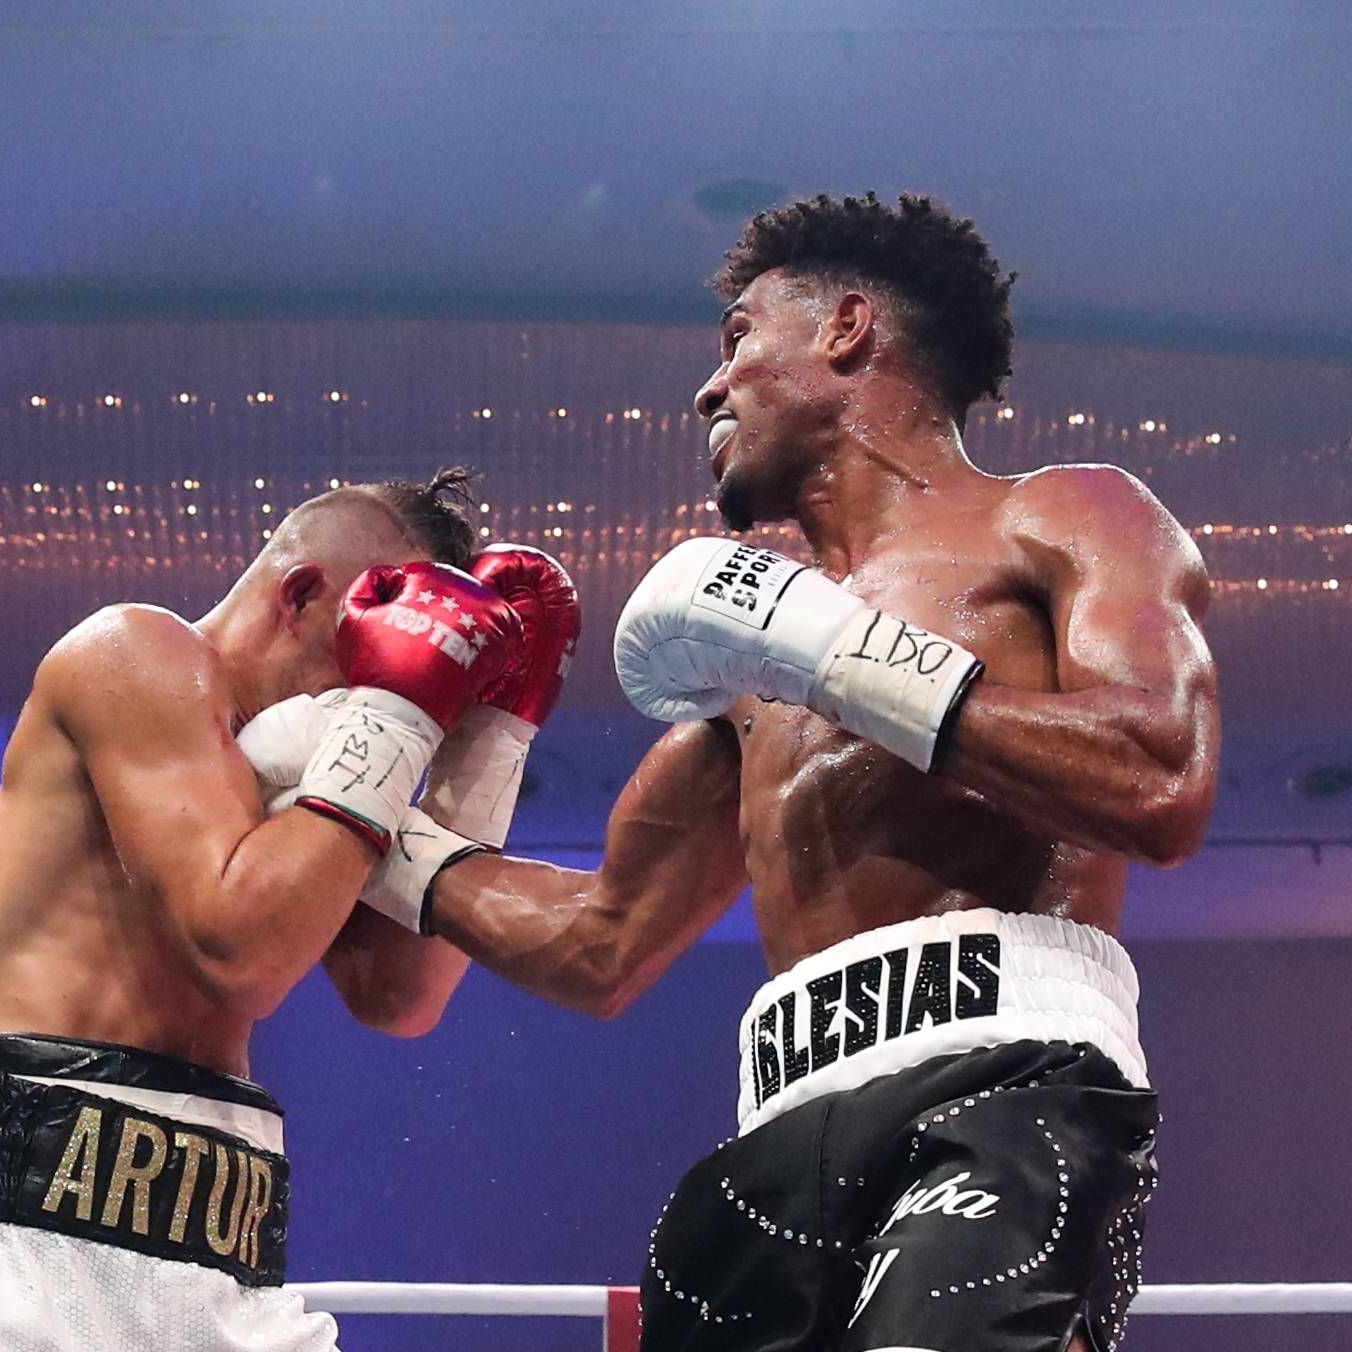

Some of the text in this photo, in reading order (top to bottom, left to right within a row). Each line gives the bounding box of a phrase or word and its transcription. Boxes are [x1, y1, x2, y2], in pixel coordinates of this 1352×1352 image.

[384, 604, 479, 669] TOP TEN
[42, 1106, 273, 1270] ARTUR
